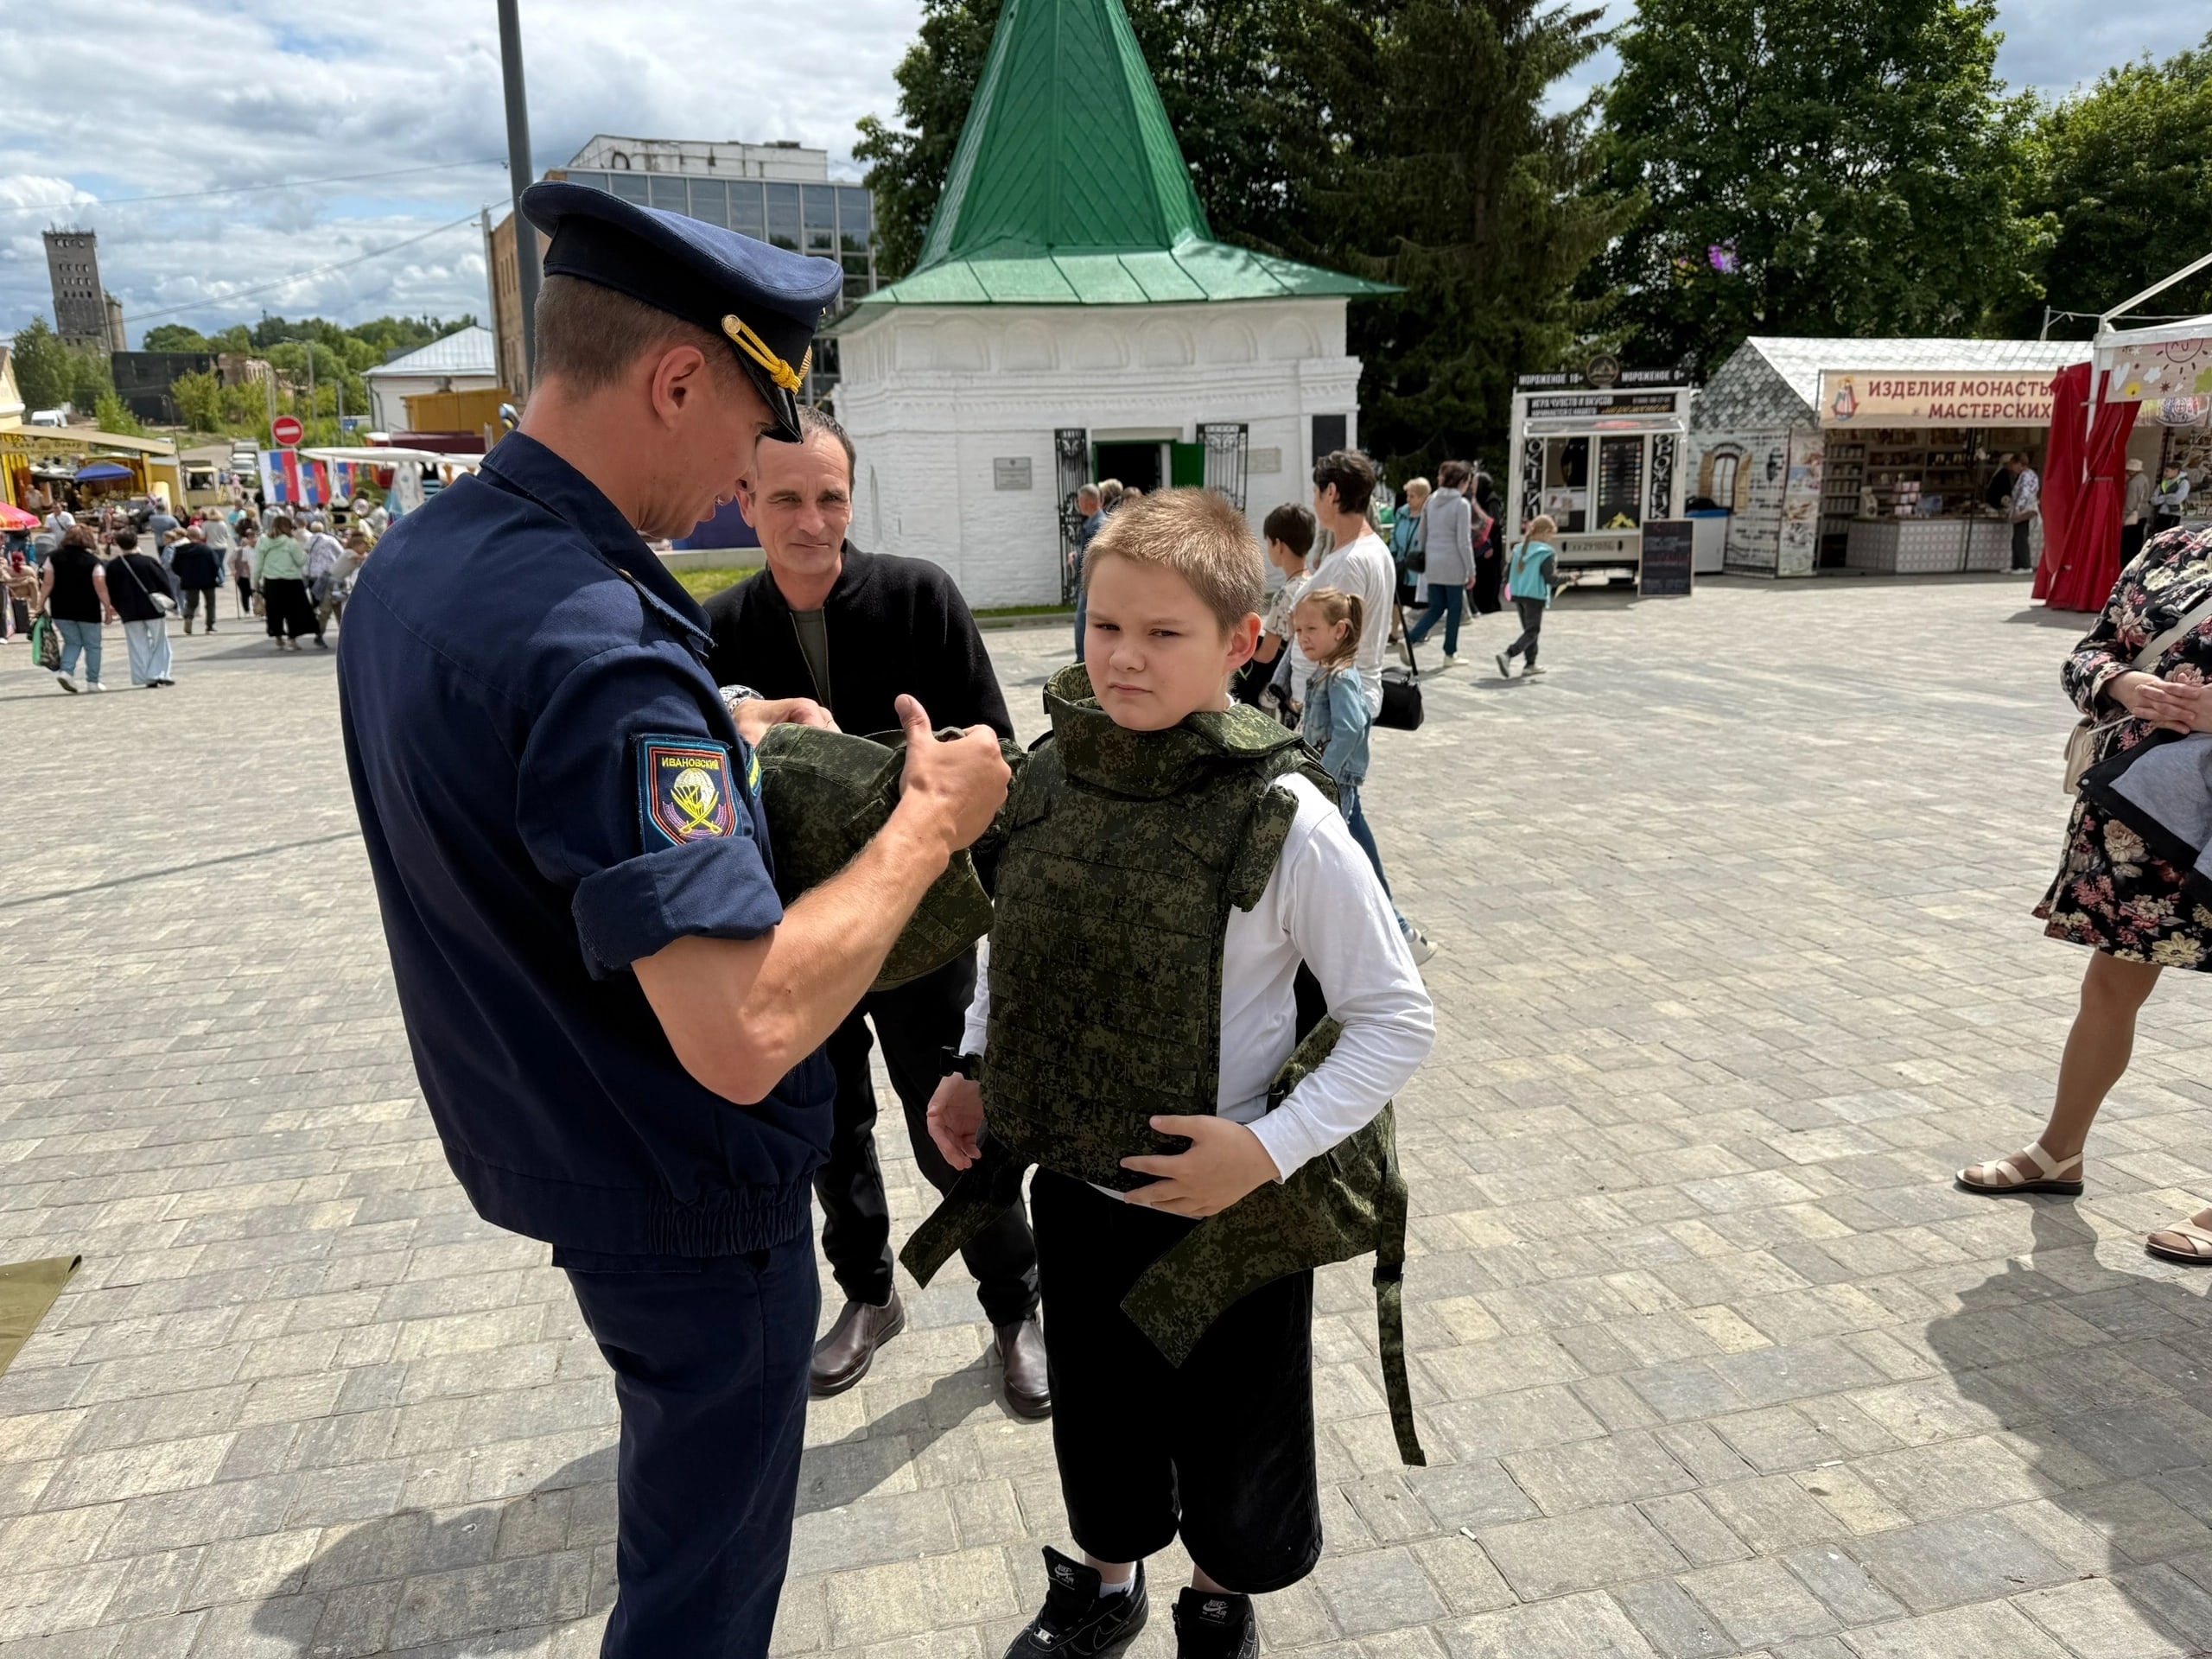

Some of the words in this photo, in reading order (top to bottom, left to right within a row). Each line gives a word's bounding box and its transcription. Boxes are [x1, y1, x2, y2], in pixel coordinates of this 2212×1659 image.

[1519, 373, 1567, 385] МОРОЖЕНОЕ
[1569, 372, 1584, 384] 18+
[1621, 370, 1670, 383] МОРОЖЕНОЕ
[1868, 380, 1956, 399] ИЗДЕЛИЯ
[1928, 403, 2051, 419] МАСТЕРСКИХ
[661, 757, 720, 770] ИВАНОВСКИЙ
